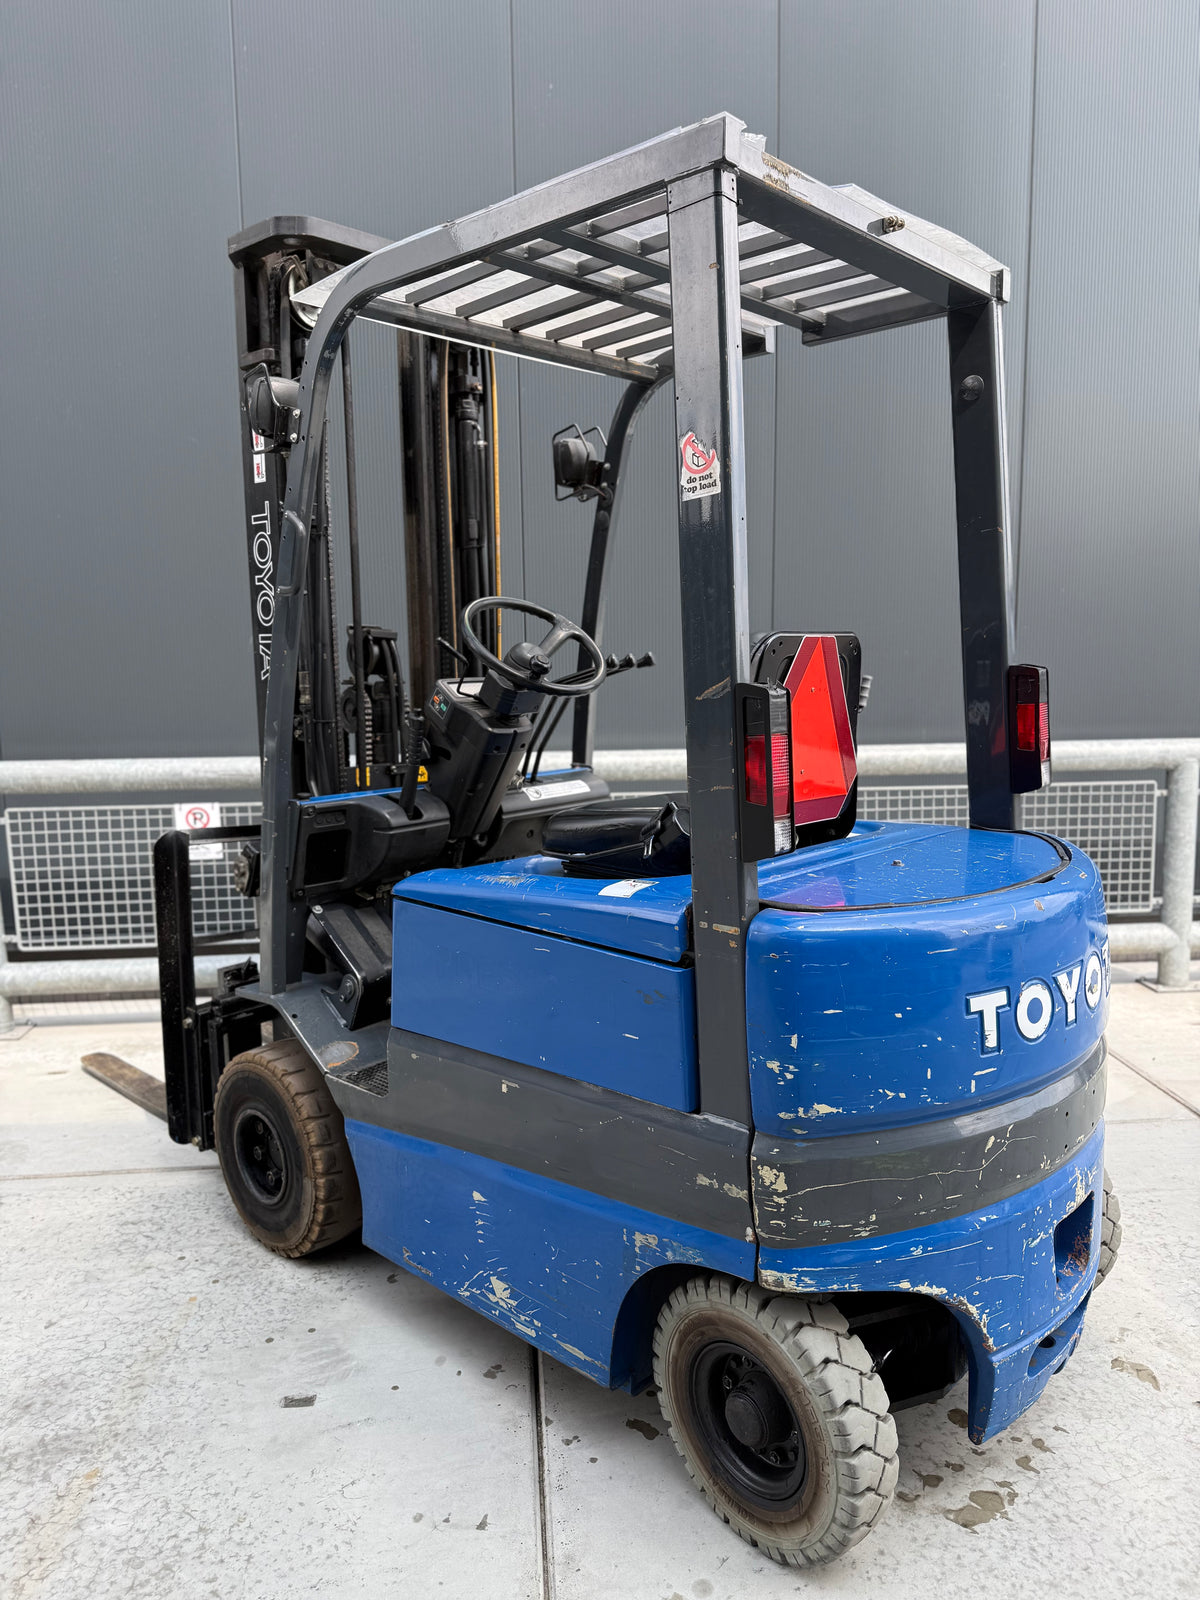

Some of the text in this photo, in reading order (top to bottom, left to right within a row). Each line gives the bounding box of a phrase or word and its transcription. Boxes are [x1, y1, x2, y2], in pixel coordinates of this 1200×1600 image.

[687, 472, 713, 484] do not
[699, 479, 717, 490] load
